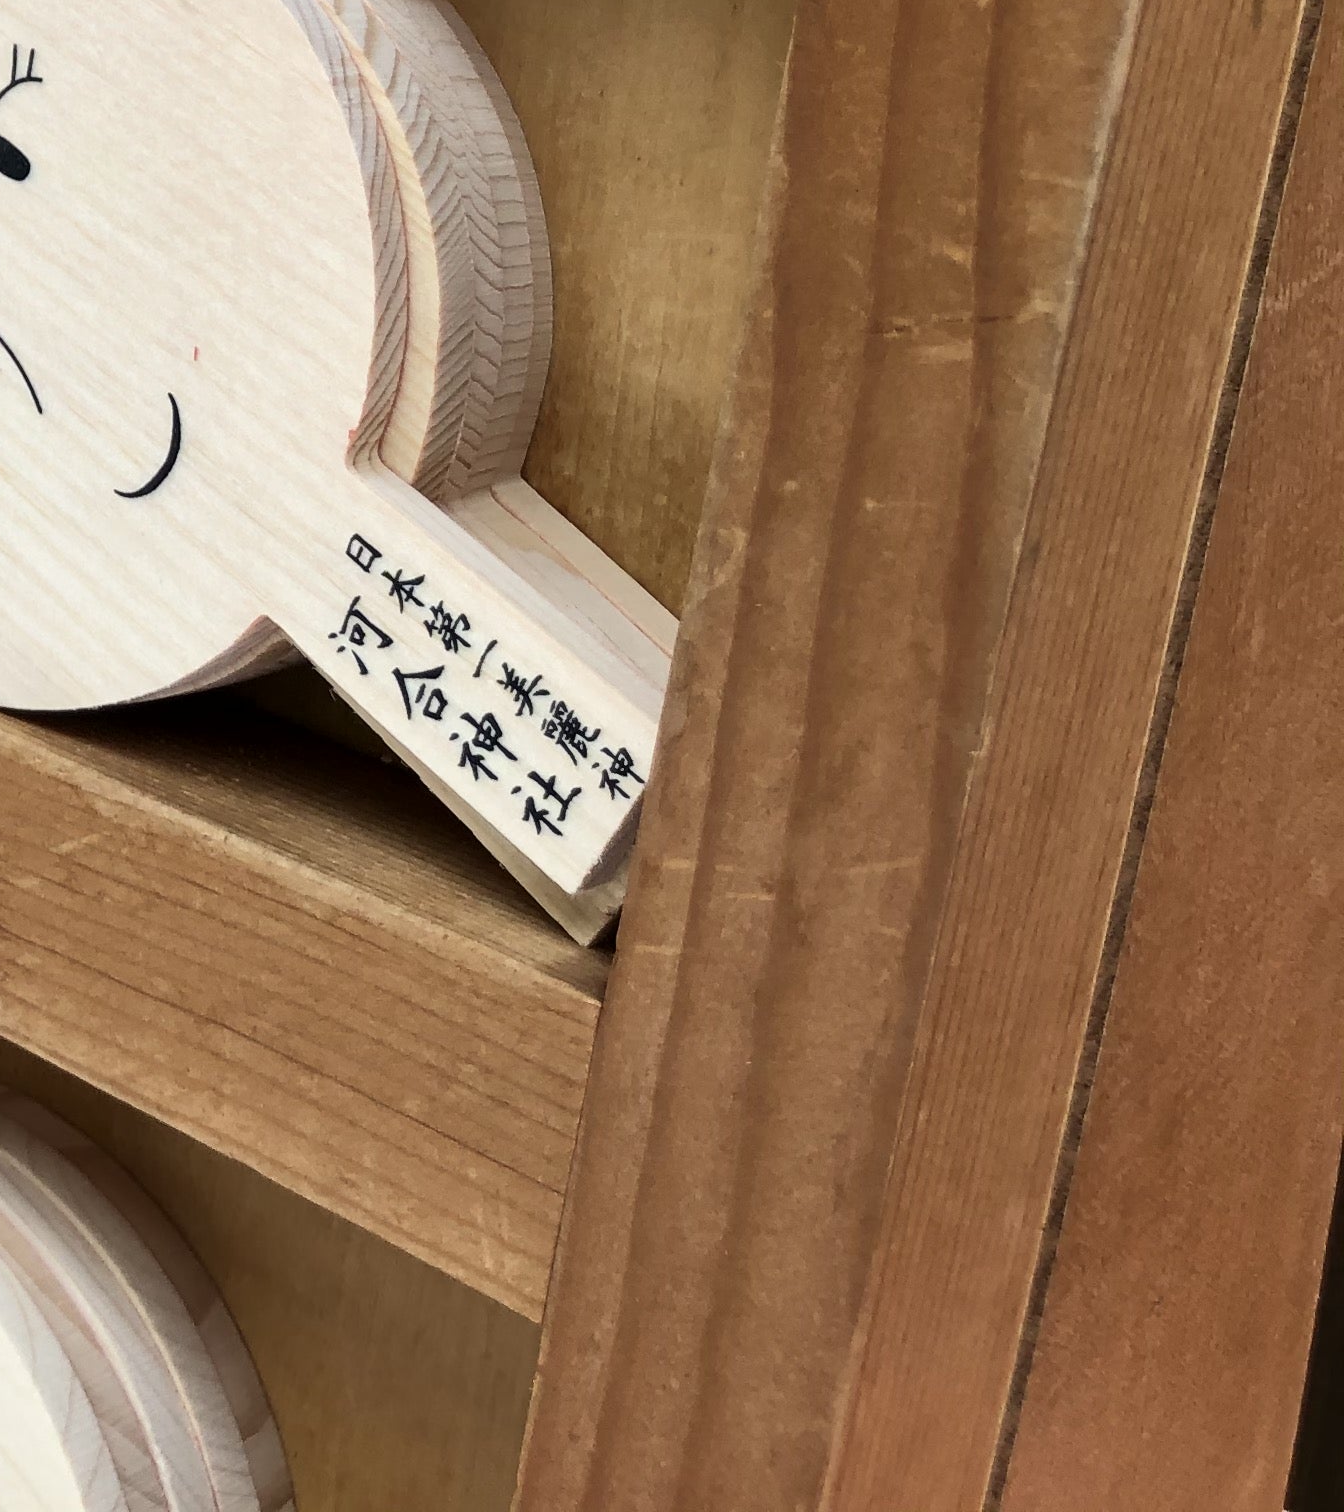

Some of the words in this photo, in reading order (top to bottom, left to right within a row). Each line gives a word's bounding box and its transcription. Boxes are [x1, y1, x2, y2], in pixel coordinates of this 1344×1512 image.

[328, 596, 581, 837] 河合神社
[346, 533, 645, 799] 日本第一美麗神
